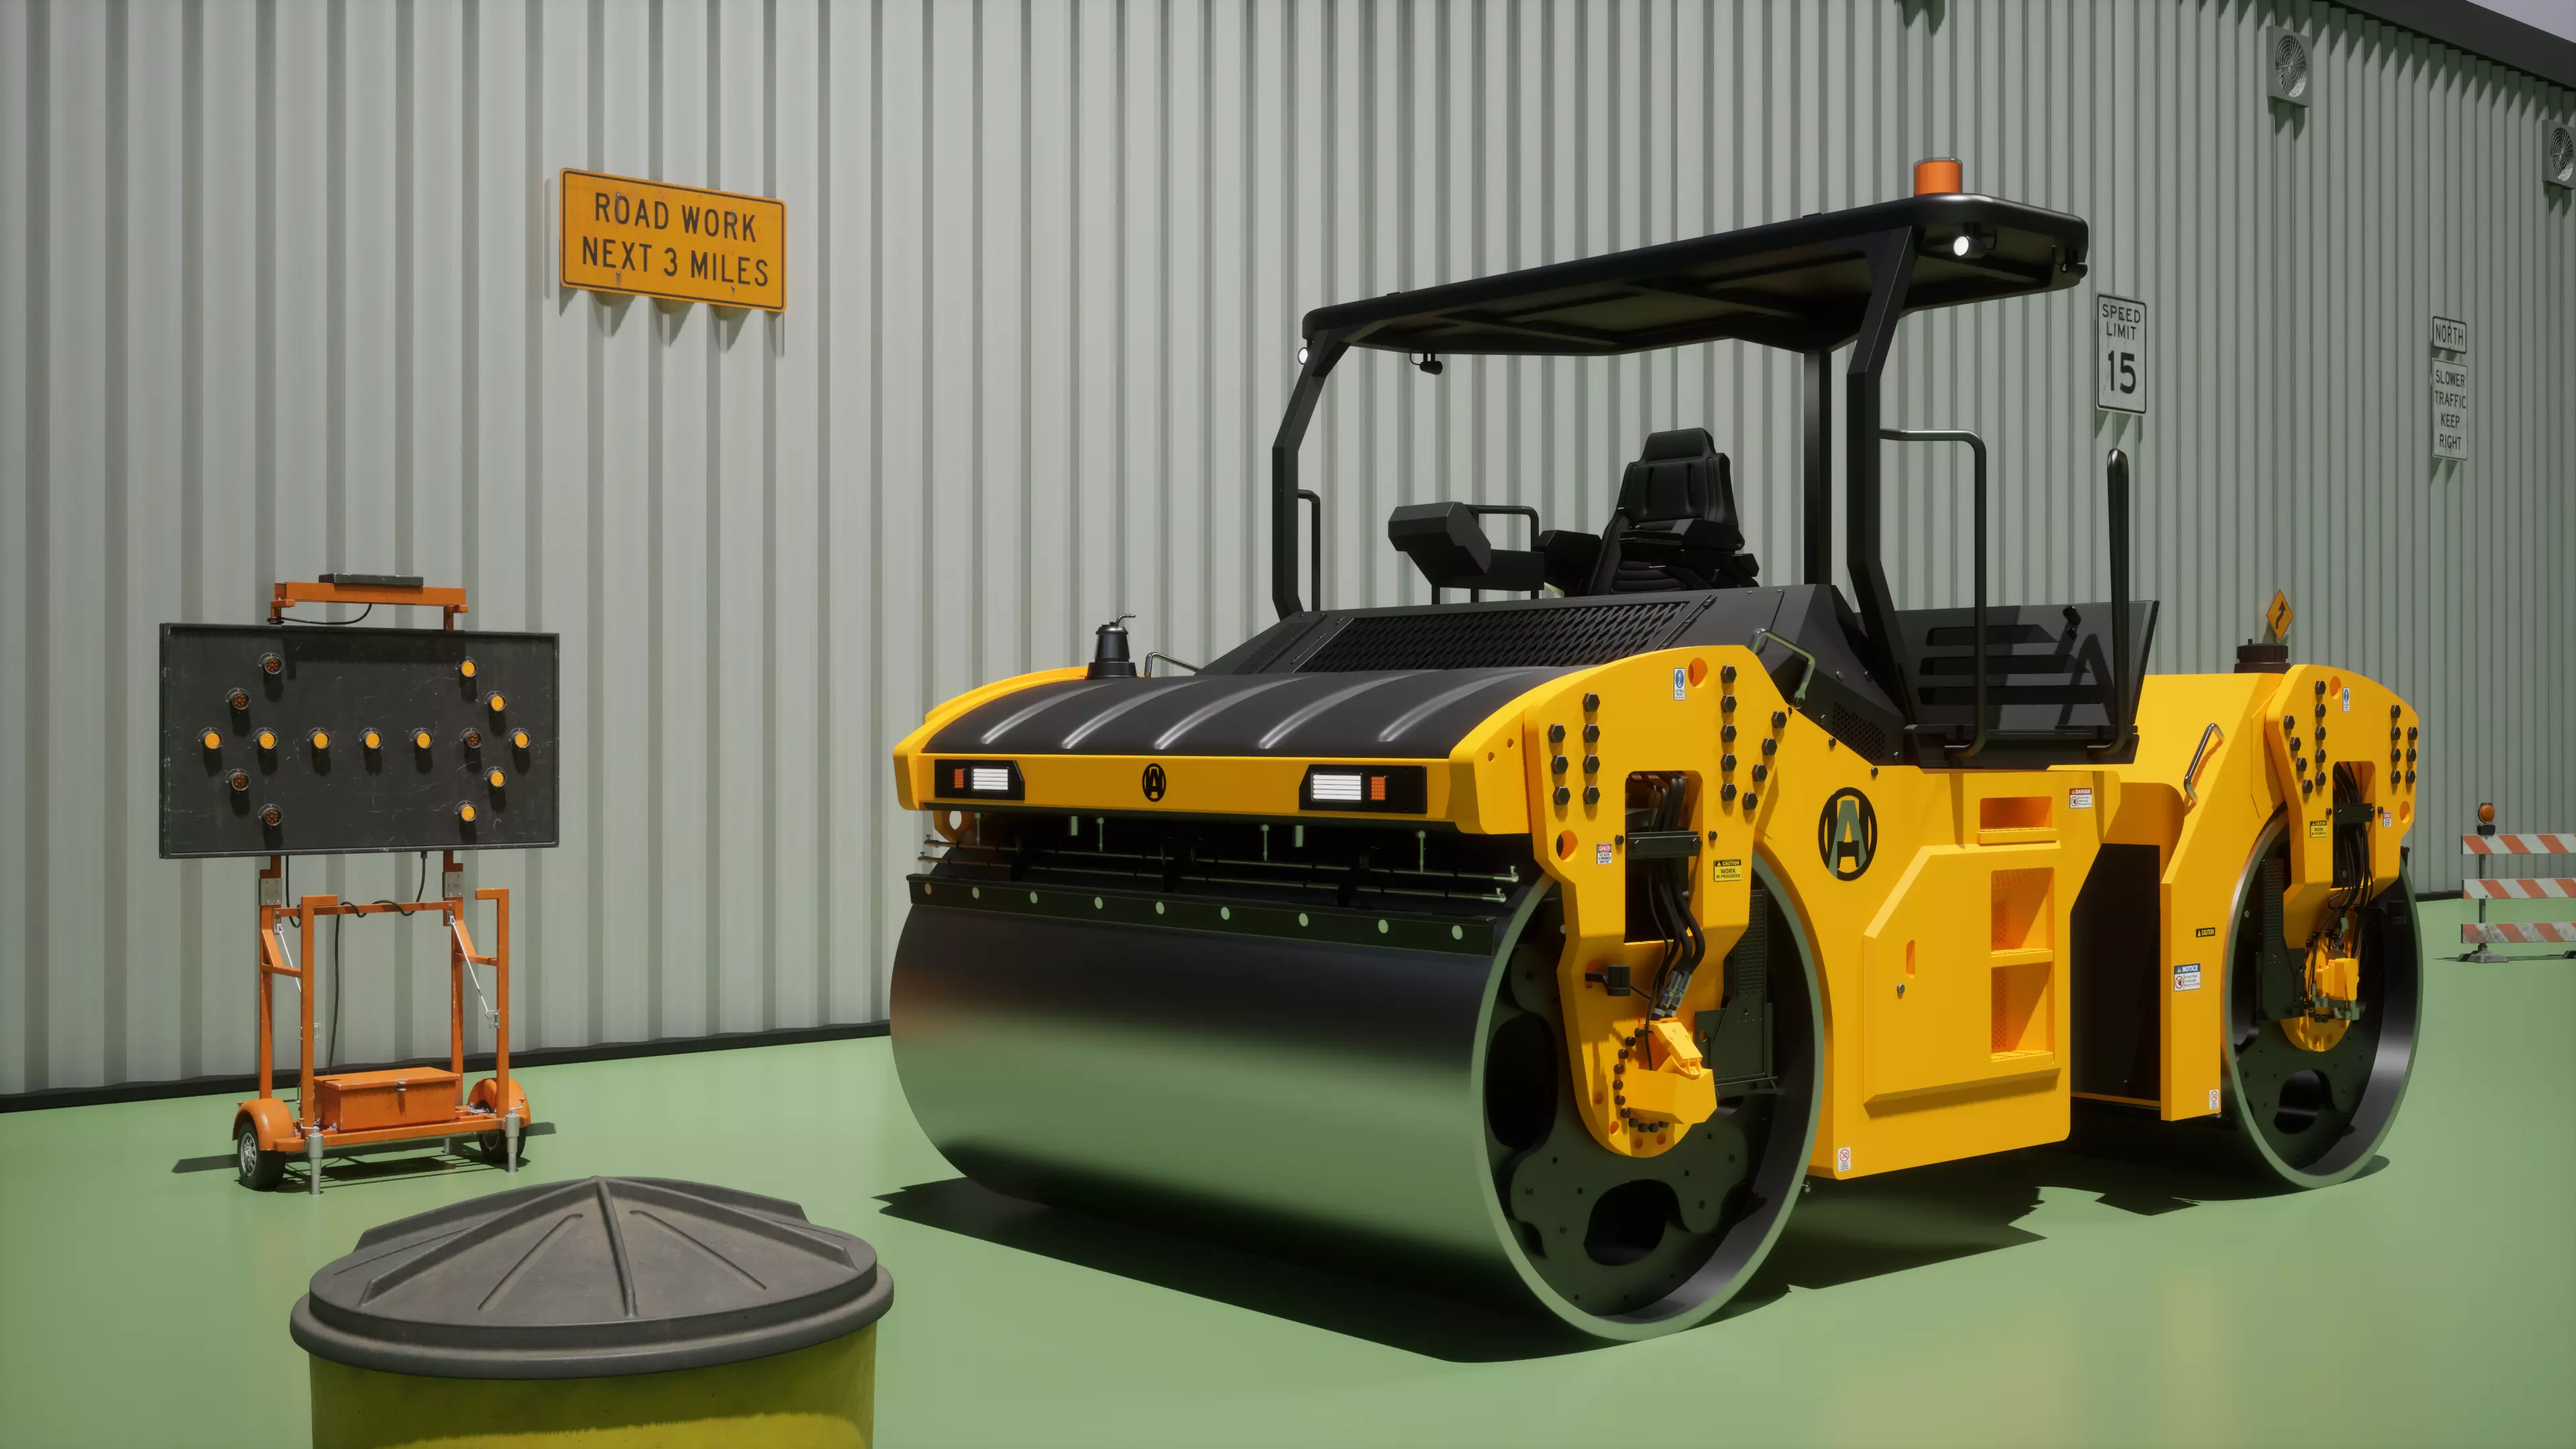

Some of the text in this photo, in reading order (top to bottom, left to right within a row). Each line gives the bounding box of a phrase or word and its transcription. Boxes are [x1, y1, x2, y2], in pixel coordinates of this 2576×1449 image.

[595, 192, 756, 242] ROAD WORK
[582, 236, 768, 286] NEXT 3 MILES
[2102, 304, 2141, 323] SPEED
[2106, 322, 2137, 340] LIMIT
[2435, 323, 2463, 346] NORTH
[2108, 350, 2136, 394] 15
[2435, 370, 2465, 388] SLOWER
[2435, 391, 2466, 409] TRAFFIC
[2440, 413, 2460, 429] KEEP
[2439, 434, 2461, 450] RIGHT
[2182, 965, 2198, 973] NOTICE
